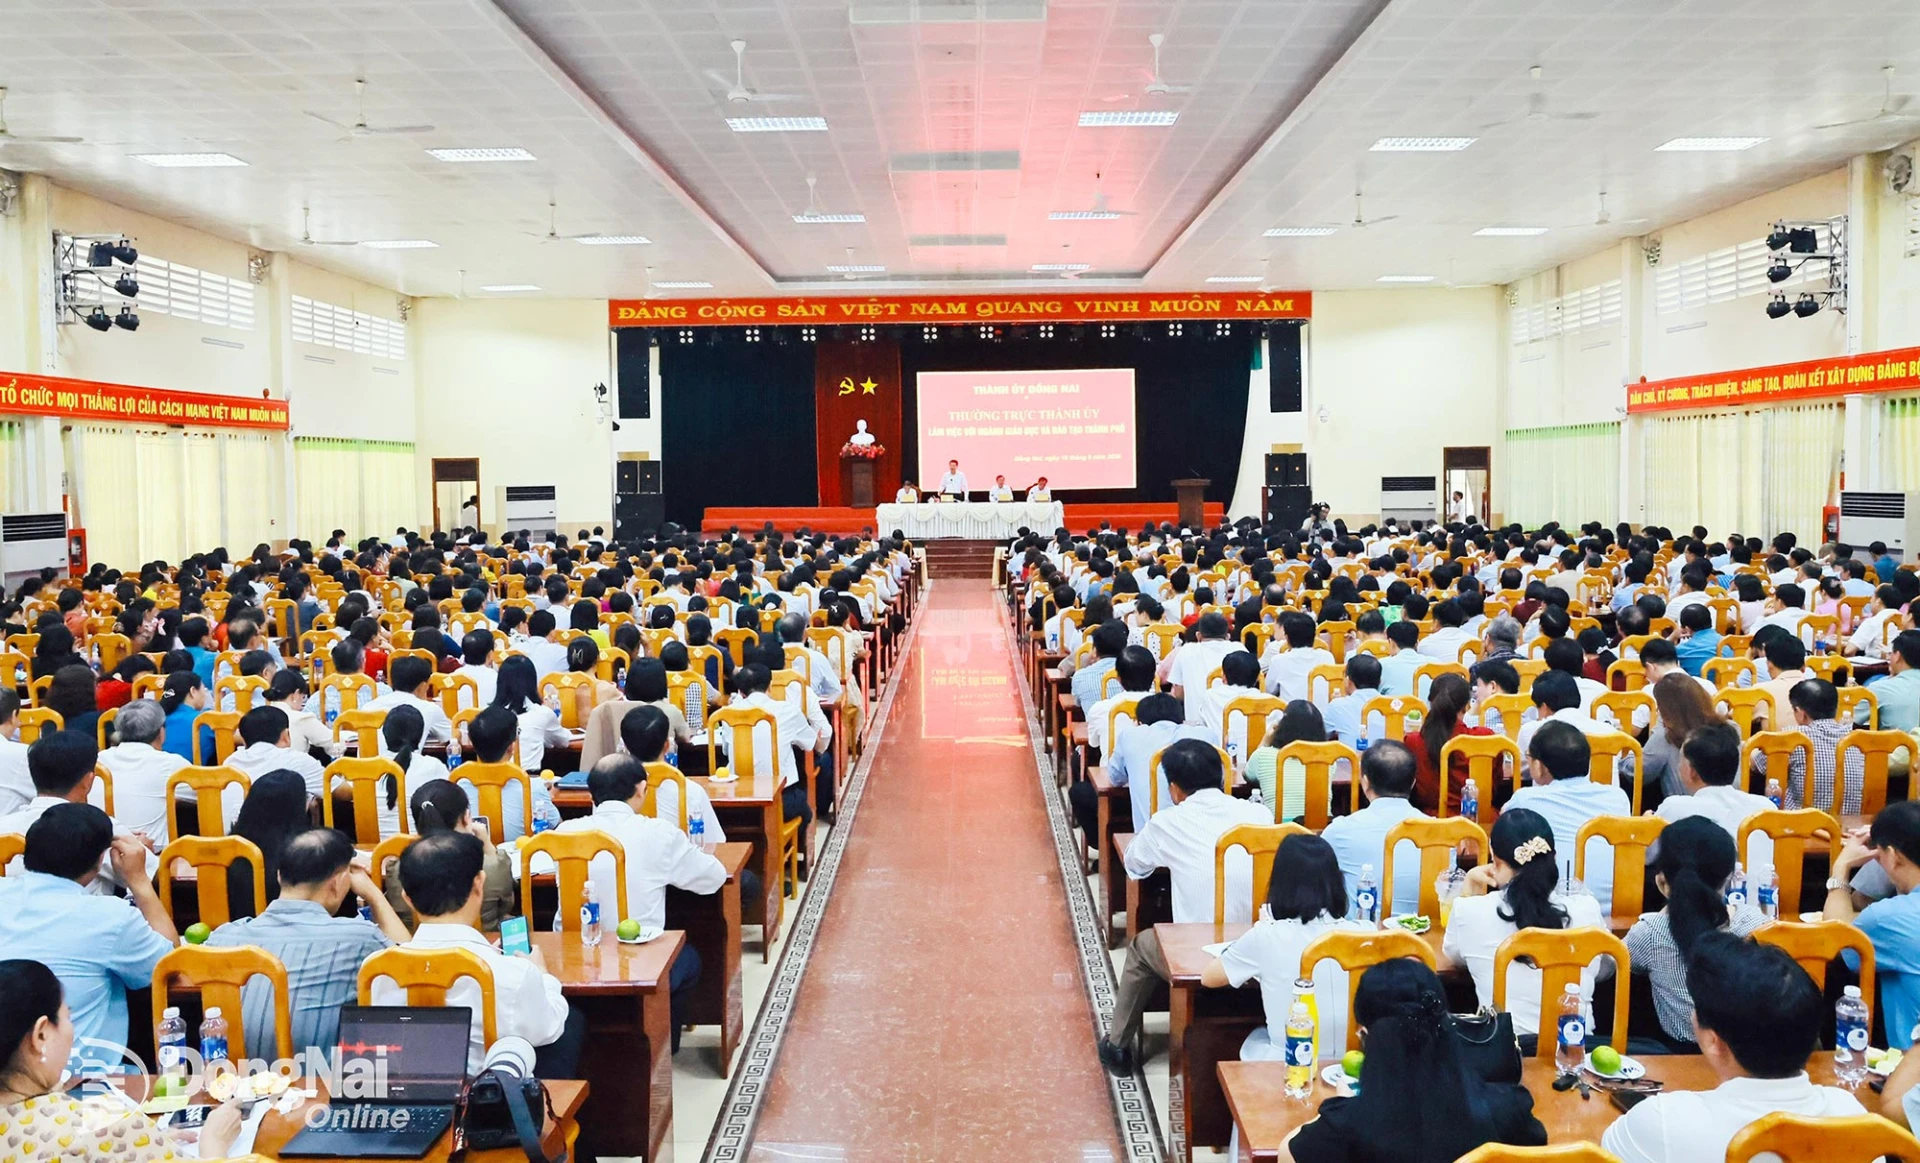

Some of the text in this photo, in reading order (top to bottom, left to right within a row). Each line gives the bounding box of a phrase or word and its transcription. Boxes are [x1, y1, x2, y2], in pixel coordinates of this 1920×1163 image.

[618, 293, 1294, 321] ĐẢNG CỘNG SẢN VIỆT NAM QUANG VINH MUÔN NĂM
[1061, 384, 1080, 394] NAI
[1692, 383, 1713, 399] TRÁCH
[1714, 380, 1740, 399] NHIỆM,
[1741, 377, 1763, 394] SÁNG
[1764, 374, 1782, 395] TẠO,
[1783, 371, 1807, 390] ĐOÀN
[1808, 366, 1826, 387] KẾT
[1827, 366, 1846, 386] XÂY
[1847, 365, 1875, 386] DỰNG
[1877, 358, 1907, 380] ĐẢNG
[0, 378, 287, 423] TỔ CHỨC MỌI THẮNG LỢI CỦA CÁCH MẠNG VIỆT NAM MUÔN NĂM
[948, 408, 1000, 421] THƯỜNG
[1002, 409, 1037, 423] TRỰC
[1038, 406, 1081, 420] THÀNH
